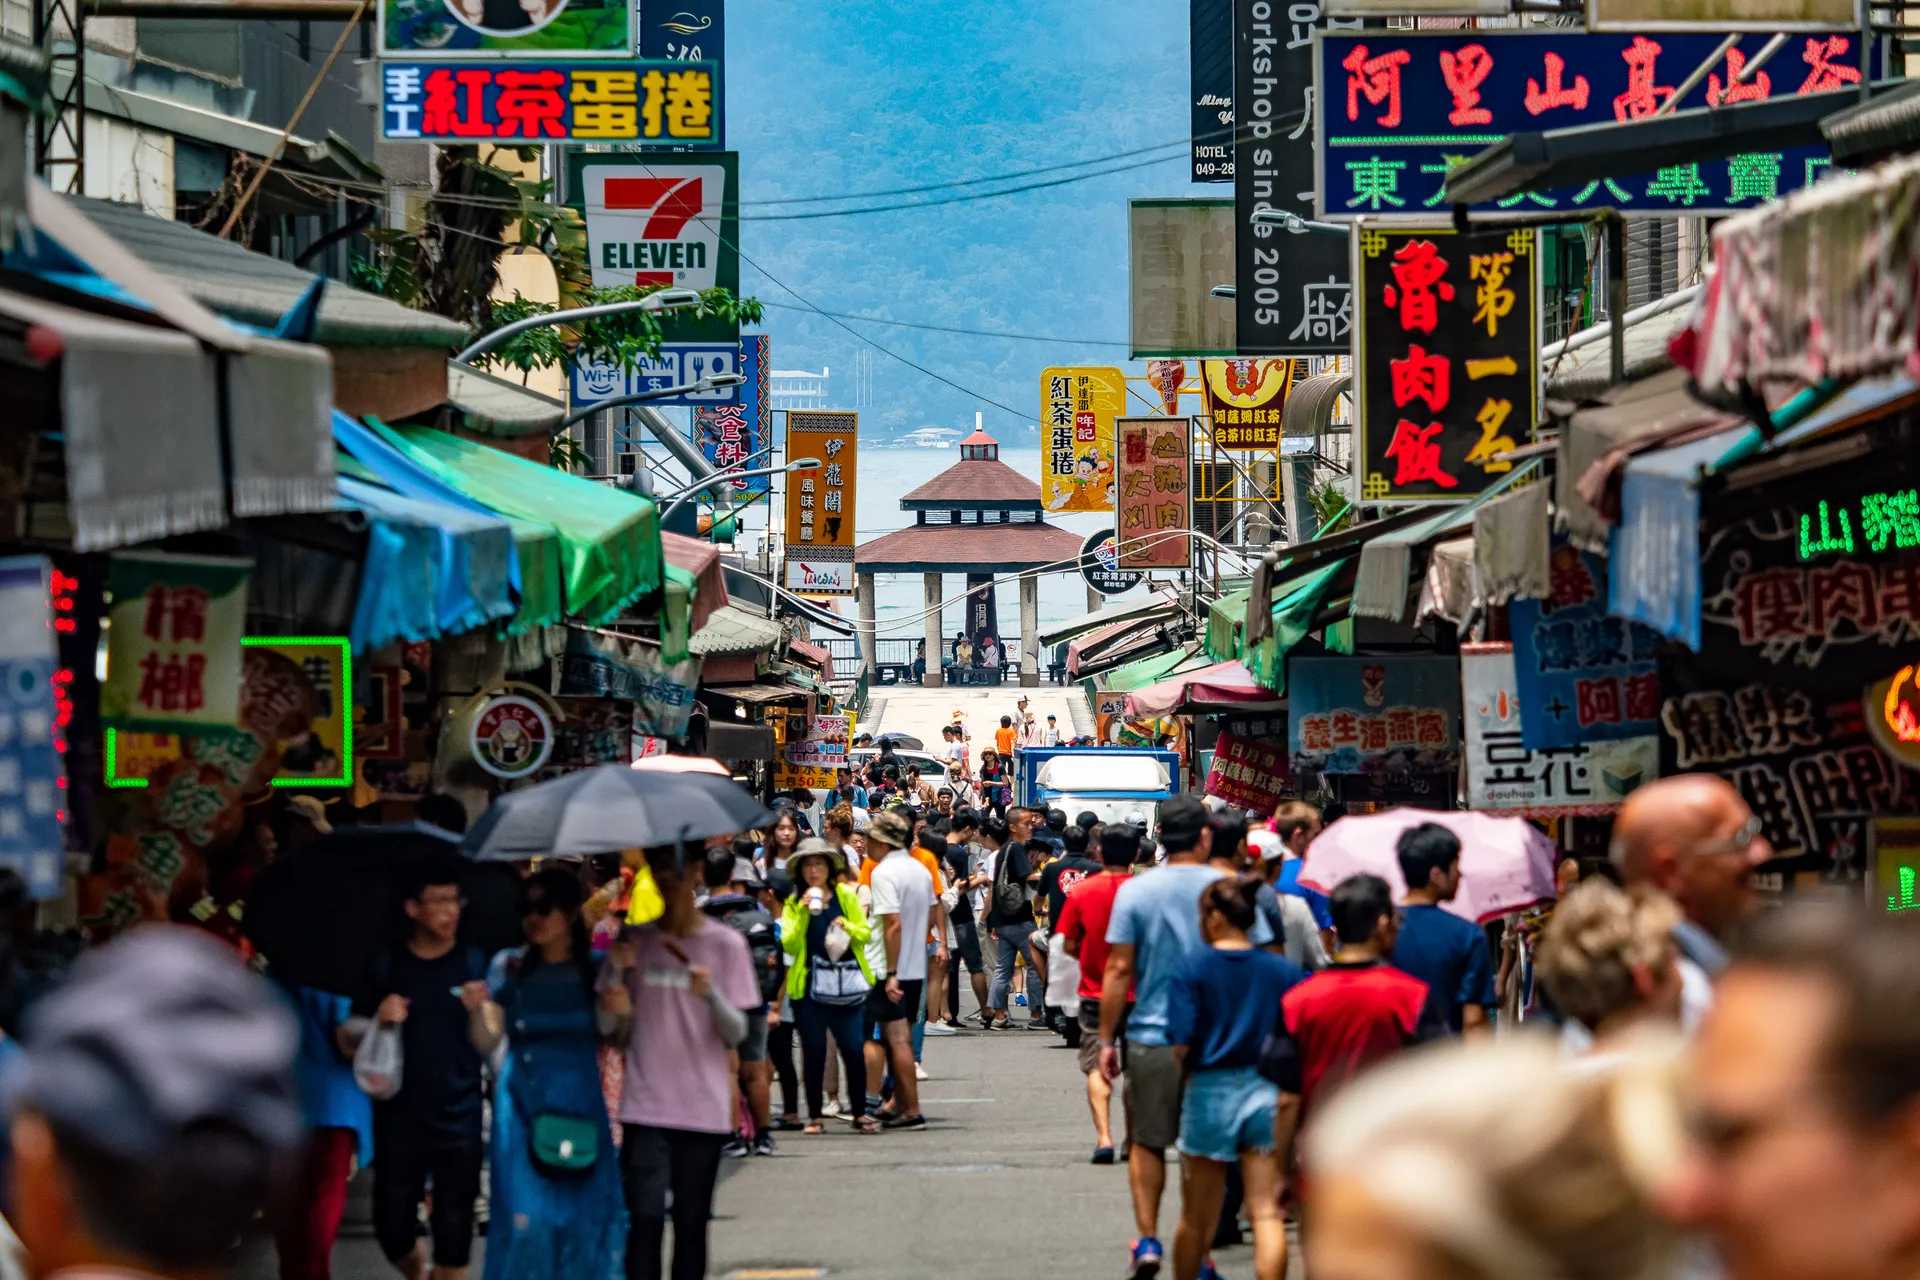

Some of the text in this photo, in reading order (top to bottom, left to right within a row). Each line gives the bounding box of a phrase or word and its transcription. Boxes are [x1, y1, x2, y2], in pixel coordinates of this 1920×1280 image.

[1342, 34, 1862, 127] 阿里山高山茶
[386, 67, 421, 138] 手工
[422, 68, 713, 138] 紅茶蛋捲
[1196, 94, 1232, 108] Ming
[1218, 110, 1234, 124] Y
[1195, 162, 1234, 175] 049-28
[1196, 145, 1227, 158] HOTEL
[1254, 249, 1280, 325] 2005
[582, 369, 621, 382] Wi-Fi
[638, 356, 674, 371] ATM
[1383, 239, 1458, 488] 魯肉飯
[1463, 252, 1518, 474] 第一名
[1077, 376, 1089, 411] 伊達邵
[1050, 376, 1074, 475] 紅茶蛋捲
[1213, 409, 1280, 425] 阿薩姆紅茶
[1214, 427, 1278, 443] 台茶18紅玉
[1151, 431, 1187, 530] 山豬肉
[800, 477, 815, 541] 風味餐廳
[1123, 469, 1157, 562] 大刈包
[1092, 571, 1137, 582] 紅茶霜淇淋
[1303, 710, 1446, 751] 養生海燕窩
[1211, 756, 1285, 794] 阿薩姆紅茶
[1481, 732, 1591, 797] 豆花
[1487, 788, 1535, 800] douhua
